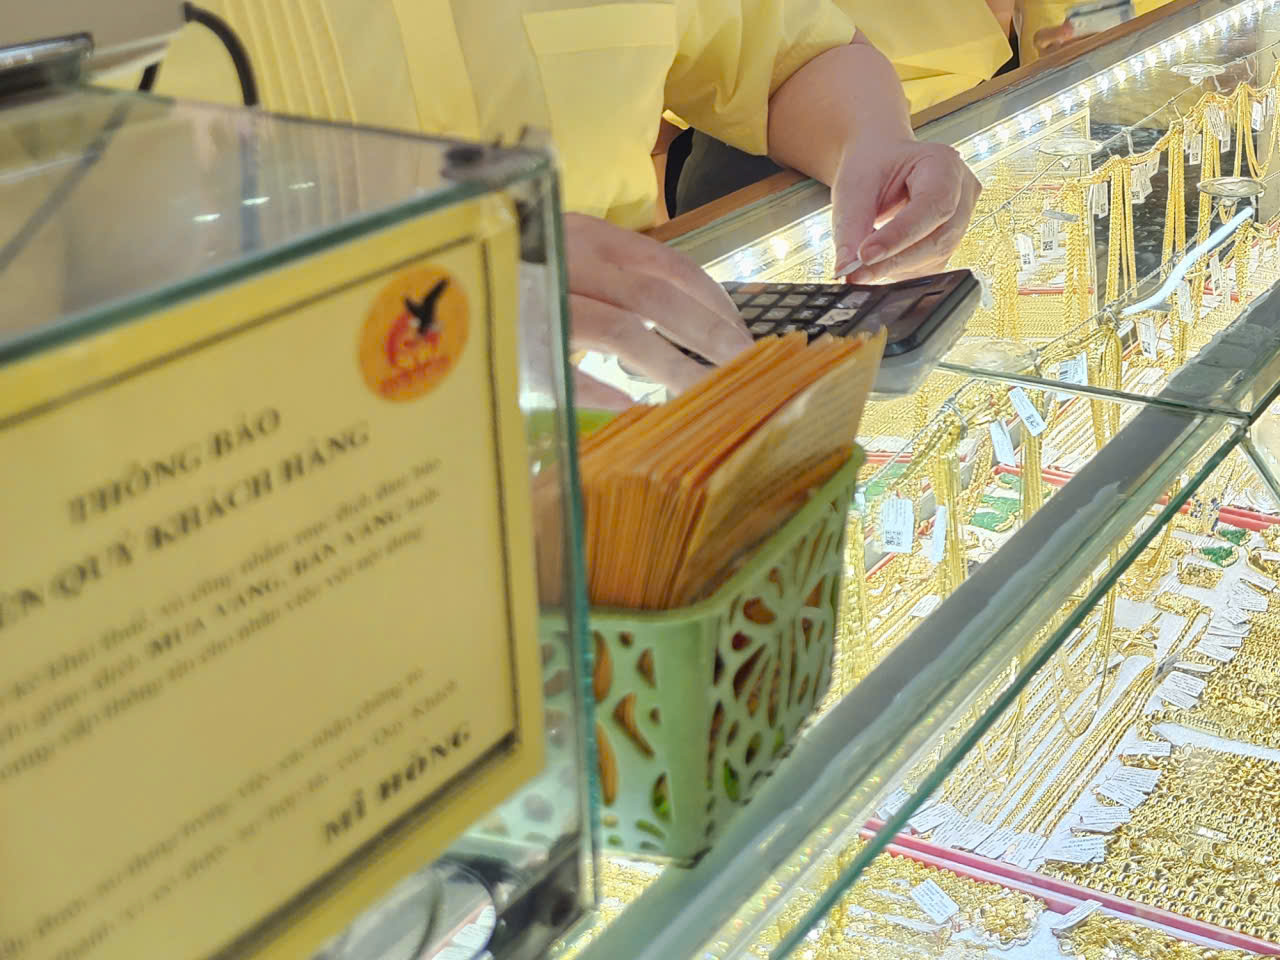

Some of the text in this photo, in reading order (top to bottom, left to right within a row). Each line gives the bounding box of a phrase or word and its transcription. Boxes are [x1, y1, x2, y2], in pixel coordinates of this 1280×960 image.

[69, 408, 280, 524] THÔNG BÁO
[281, 421, 370, 483] HÀNG
